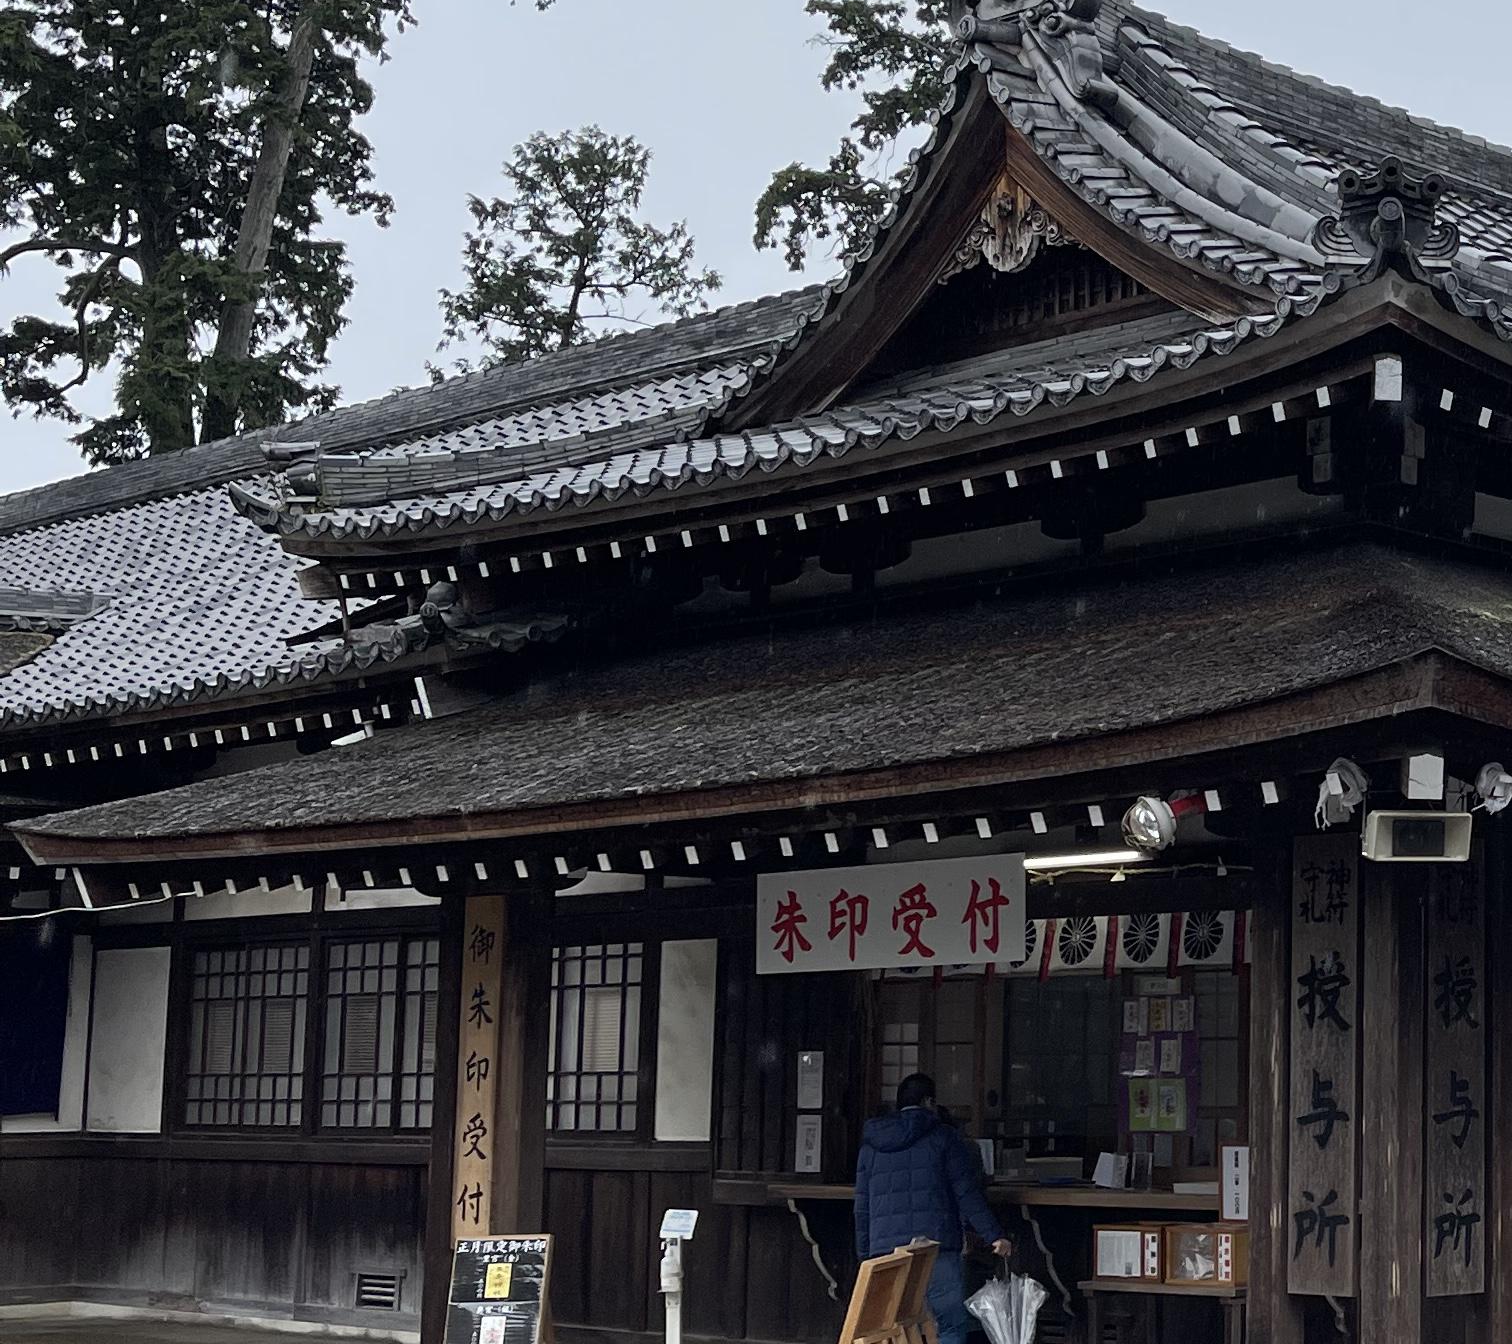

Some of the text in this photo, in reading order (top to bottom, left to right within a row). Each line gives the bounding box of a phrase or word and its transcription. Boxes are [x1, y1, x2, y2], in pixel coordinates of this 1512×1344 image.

[771, 877, 1010, 962] 朱印受付
[456, 924, 495, 1225] 御朱印受付
[1294, 954, 1352, 1268] 授与所
[1432, 960, 1481, 1268] 授与所
[456, 1240, 546, 1254] 正月限定御朱印
